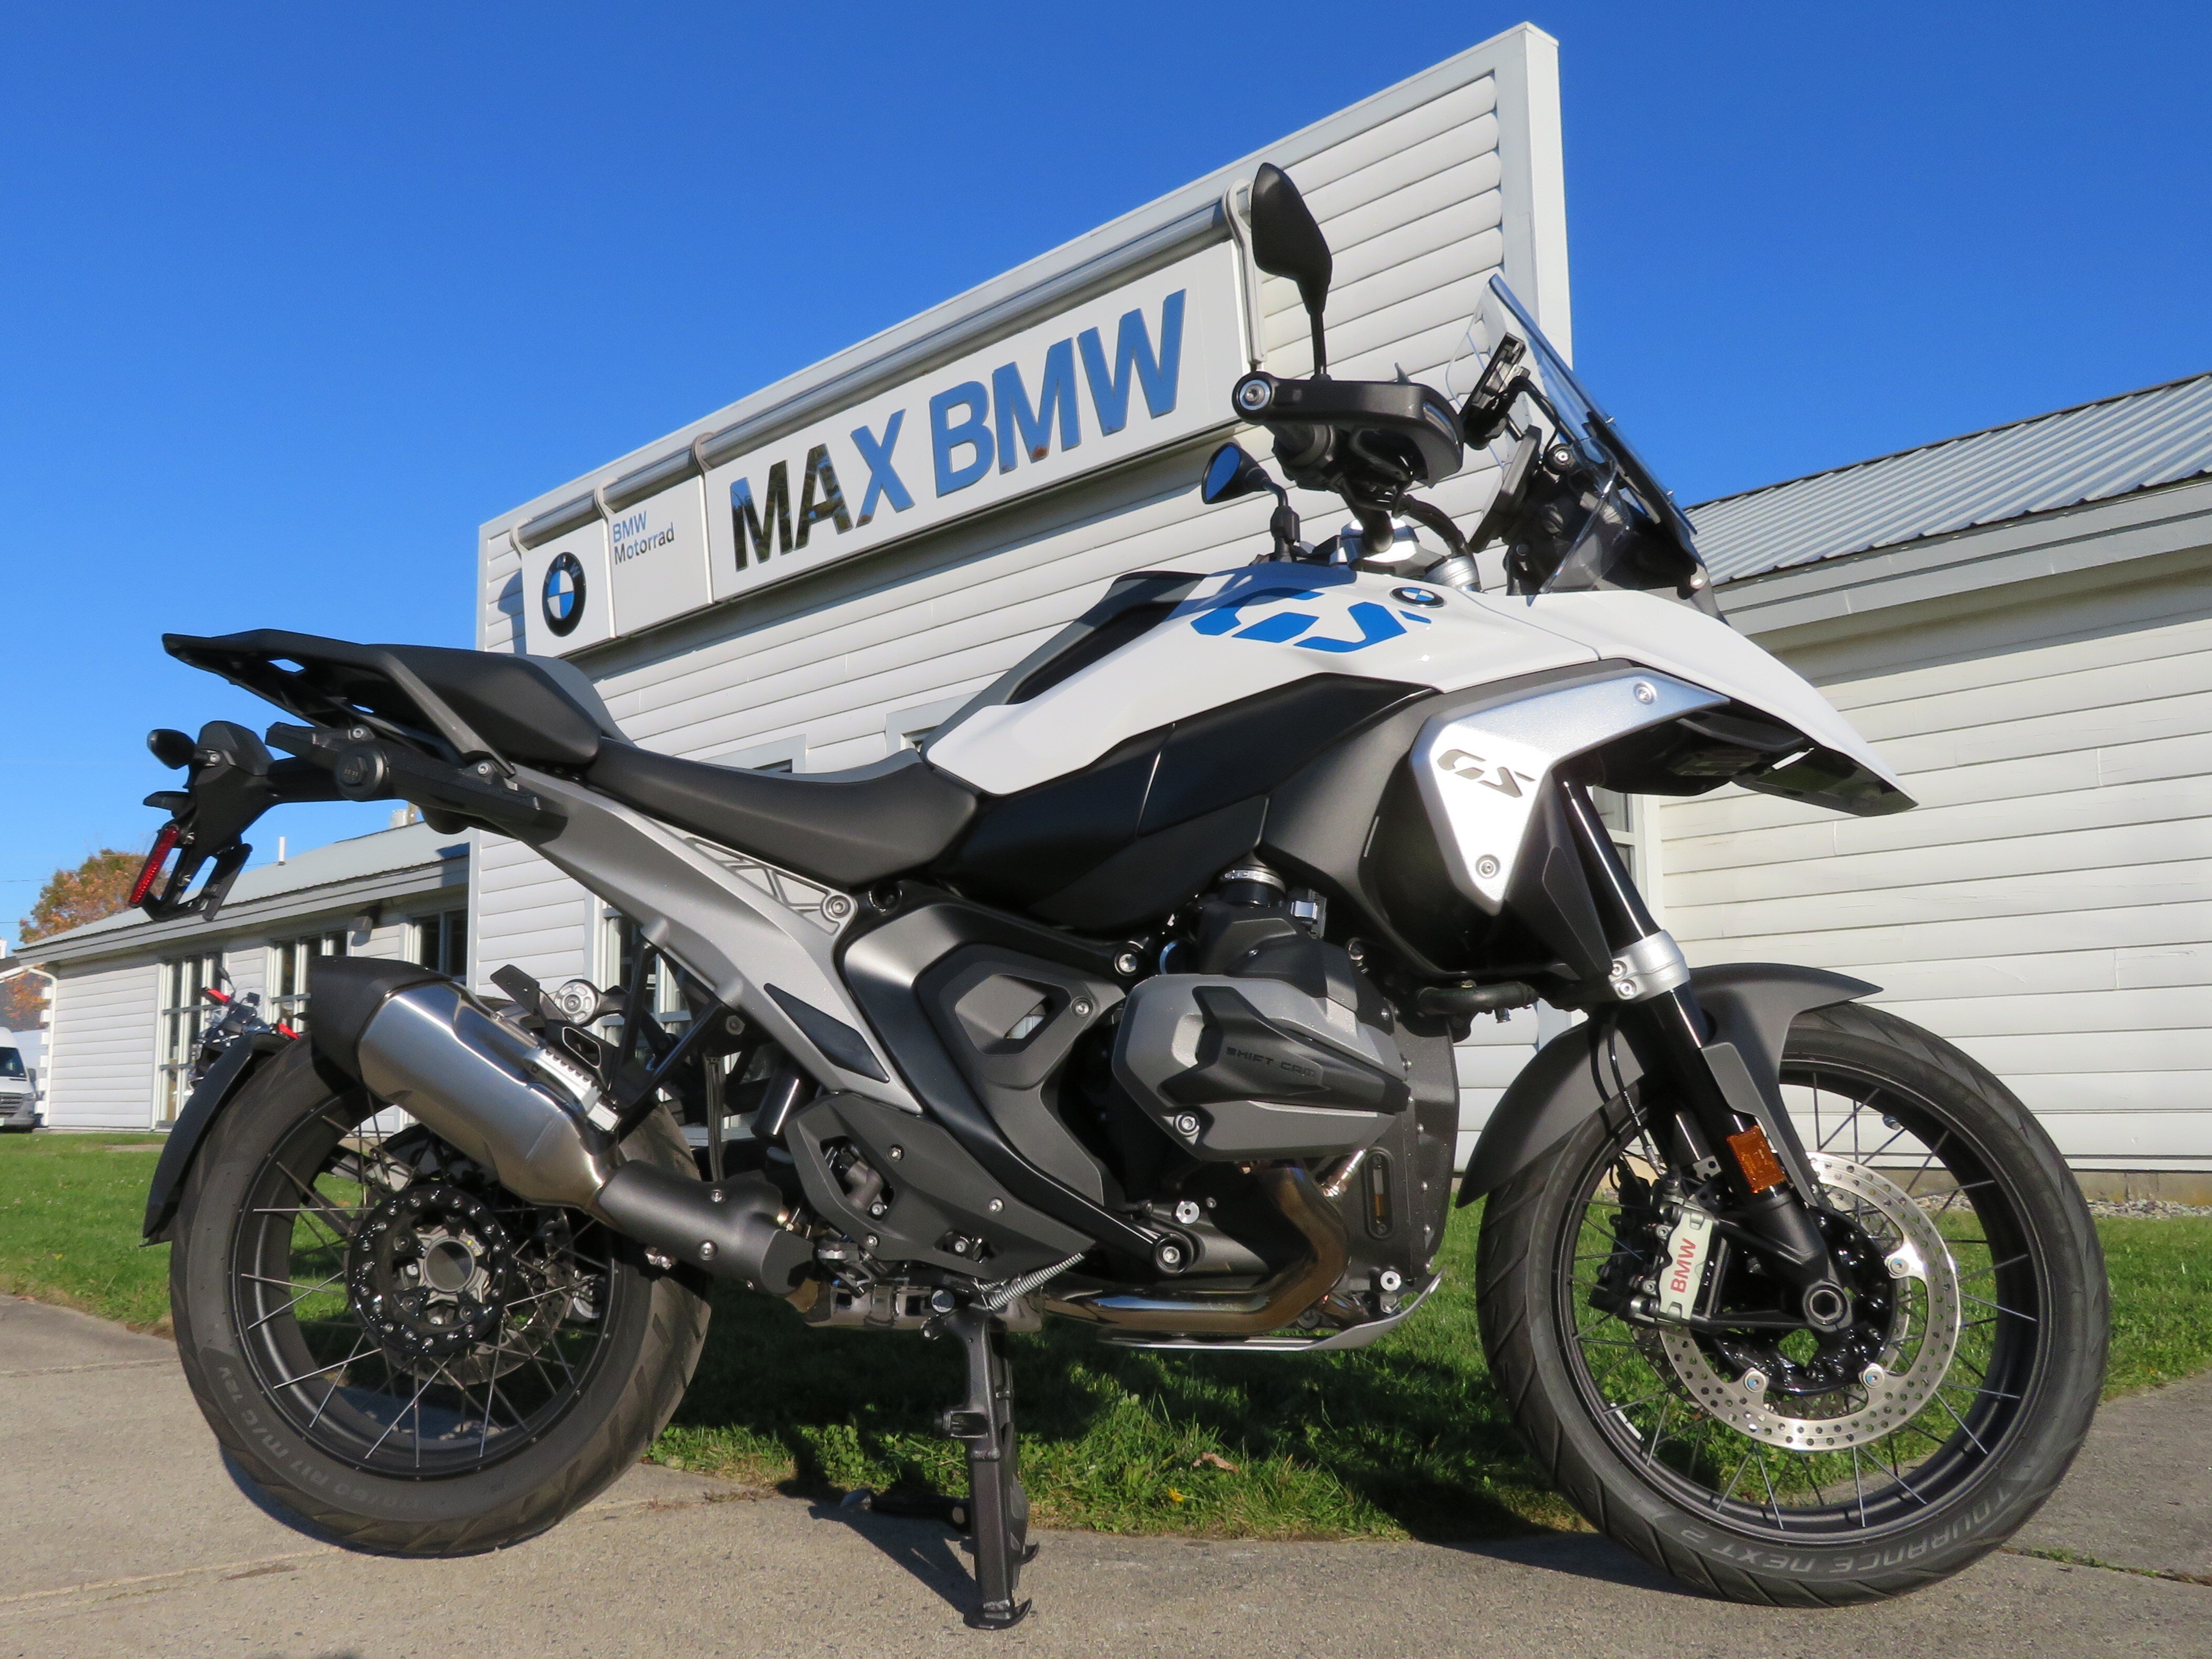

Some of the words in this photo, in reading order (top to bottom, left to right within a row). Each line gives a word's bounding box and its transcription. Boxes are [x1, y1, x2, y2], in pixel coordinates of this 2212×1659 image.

[730, 408, 916, 572] MAX
[929, 288, 1187, 498] BMW
[613, 510, 647, 544] BMW
[614, 522, 675, 566] Motorrad
[1226, 1046, 1274, 1066] SHIFT
[1670, 1238, 1696, 1294] BMW
[1829, 1486, 2013, 1575] TOURANCE
